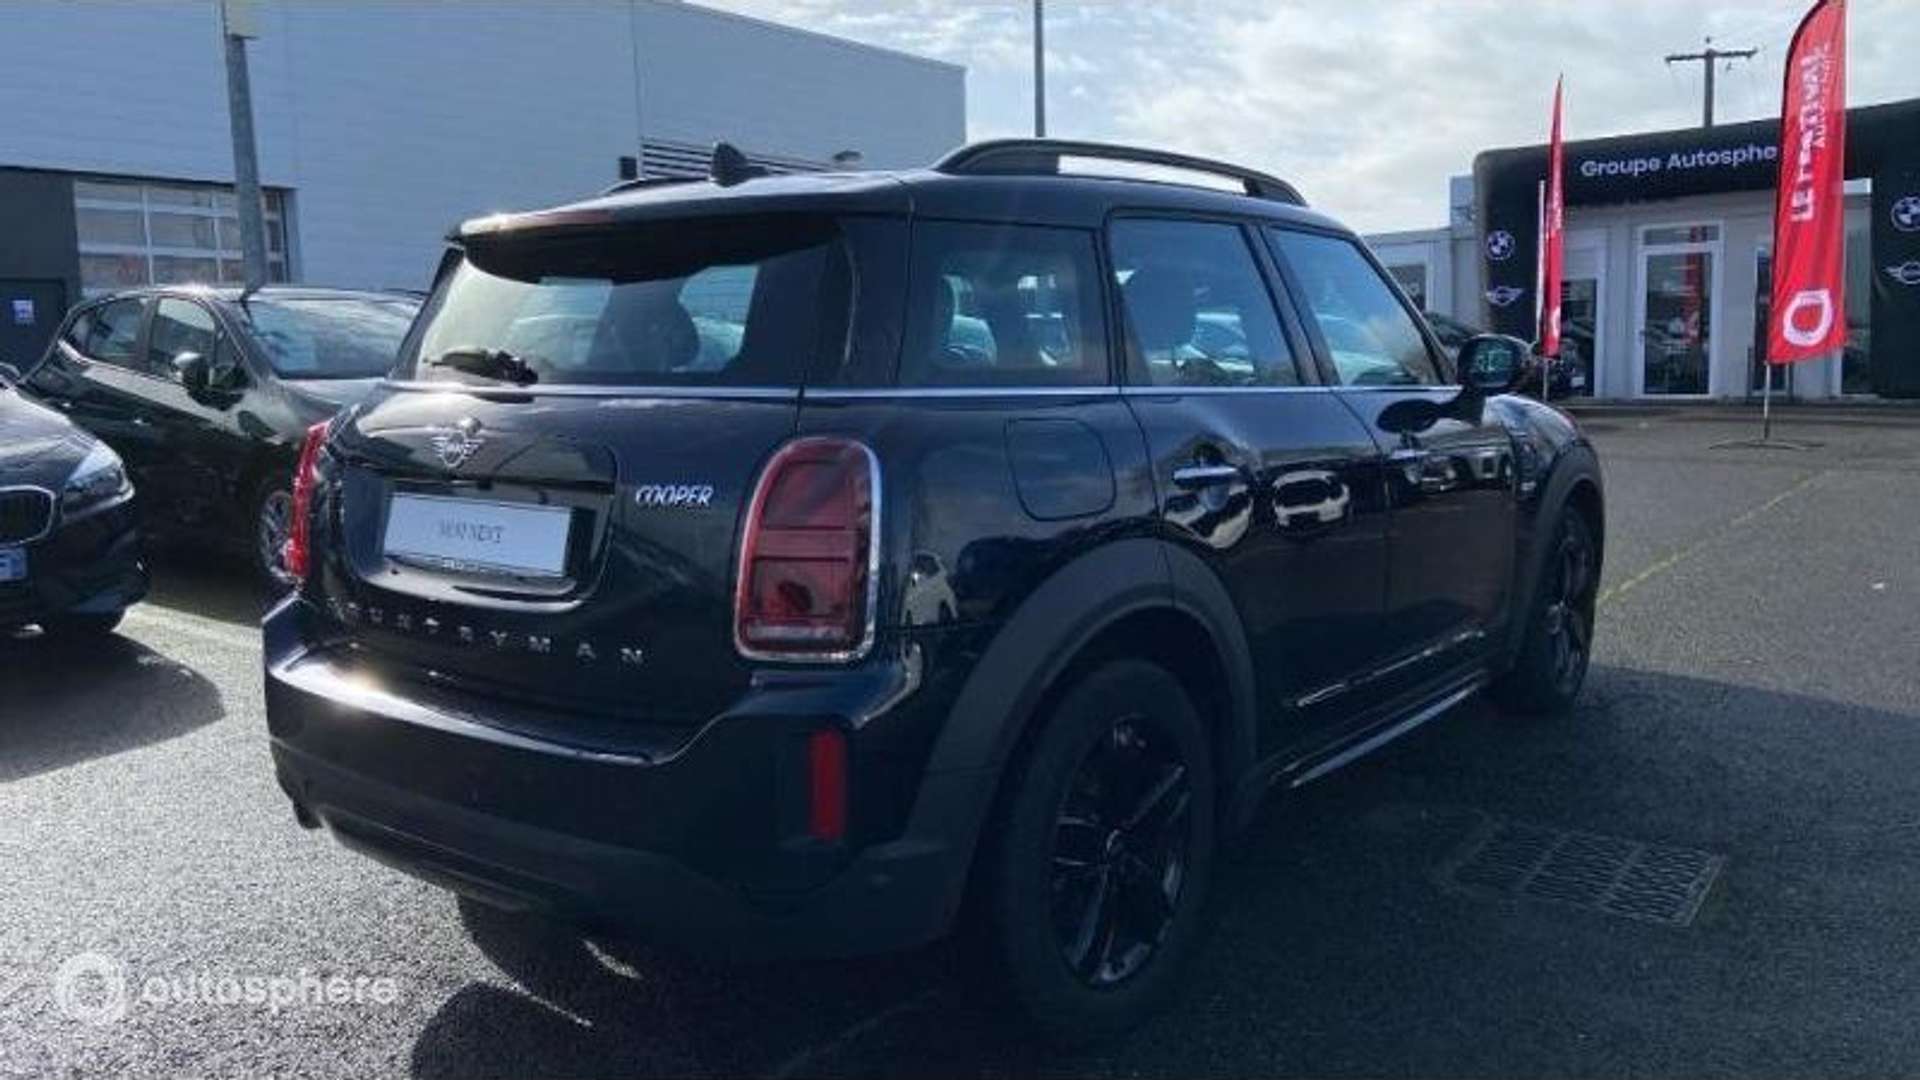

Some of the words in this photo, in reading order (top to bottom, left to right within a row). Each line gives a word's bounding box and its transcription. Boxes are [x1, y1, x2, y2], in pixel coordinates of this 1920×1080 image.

[1580, 158, 1660, 177] Groupe
[1667, 143, 1779, 168] Autosphe
[635, 484, 714, 507] COOPER
